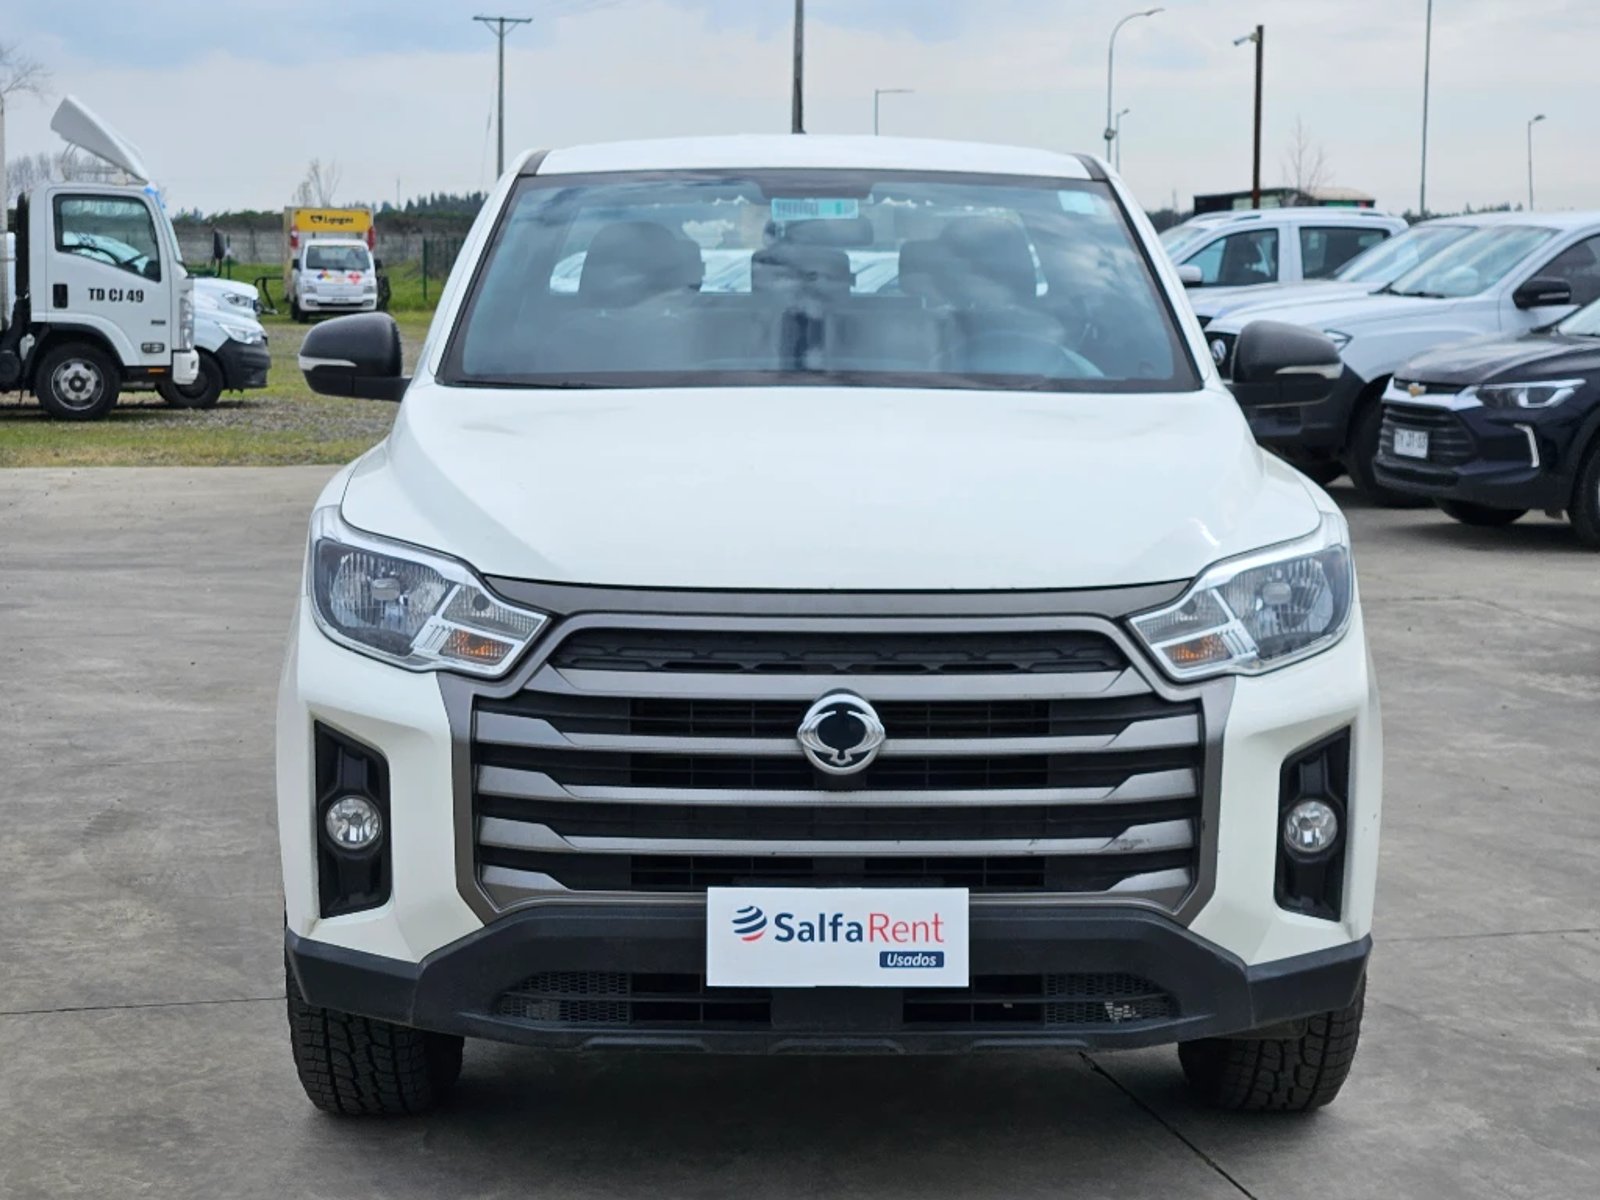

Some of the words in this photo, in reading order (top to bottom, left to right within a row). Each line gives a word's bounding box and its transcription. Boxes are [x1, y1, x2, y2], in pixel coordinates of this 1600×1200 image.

[88, 288, 105, 301] TD
[108, 288, 123, 302] CJ
[126, 289, 144, 303] 49
[774, 913, 945, 943] SalfaRent
[886, 952, 937, 967] Usados
